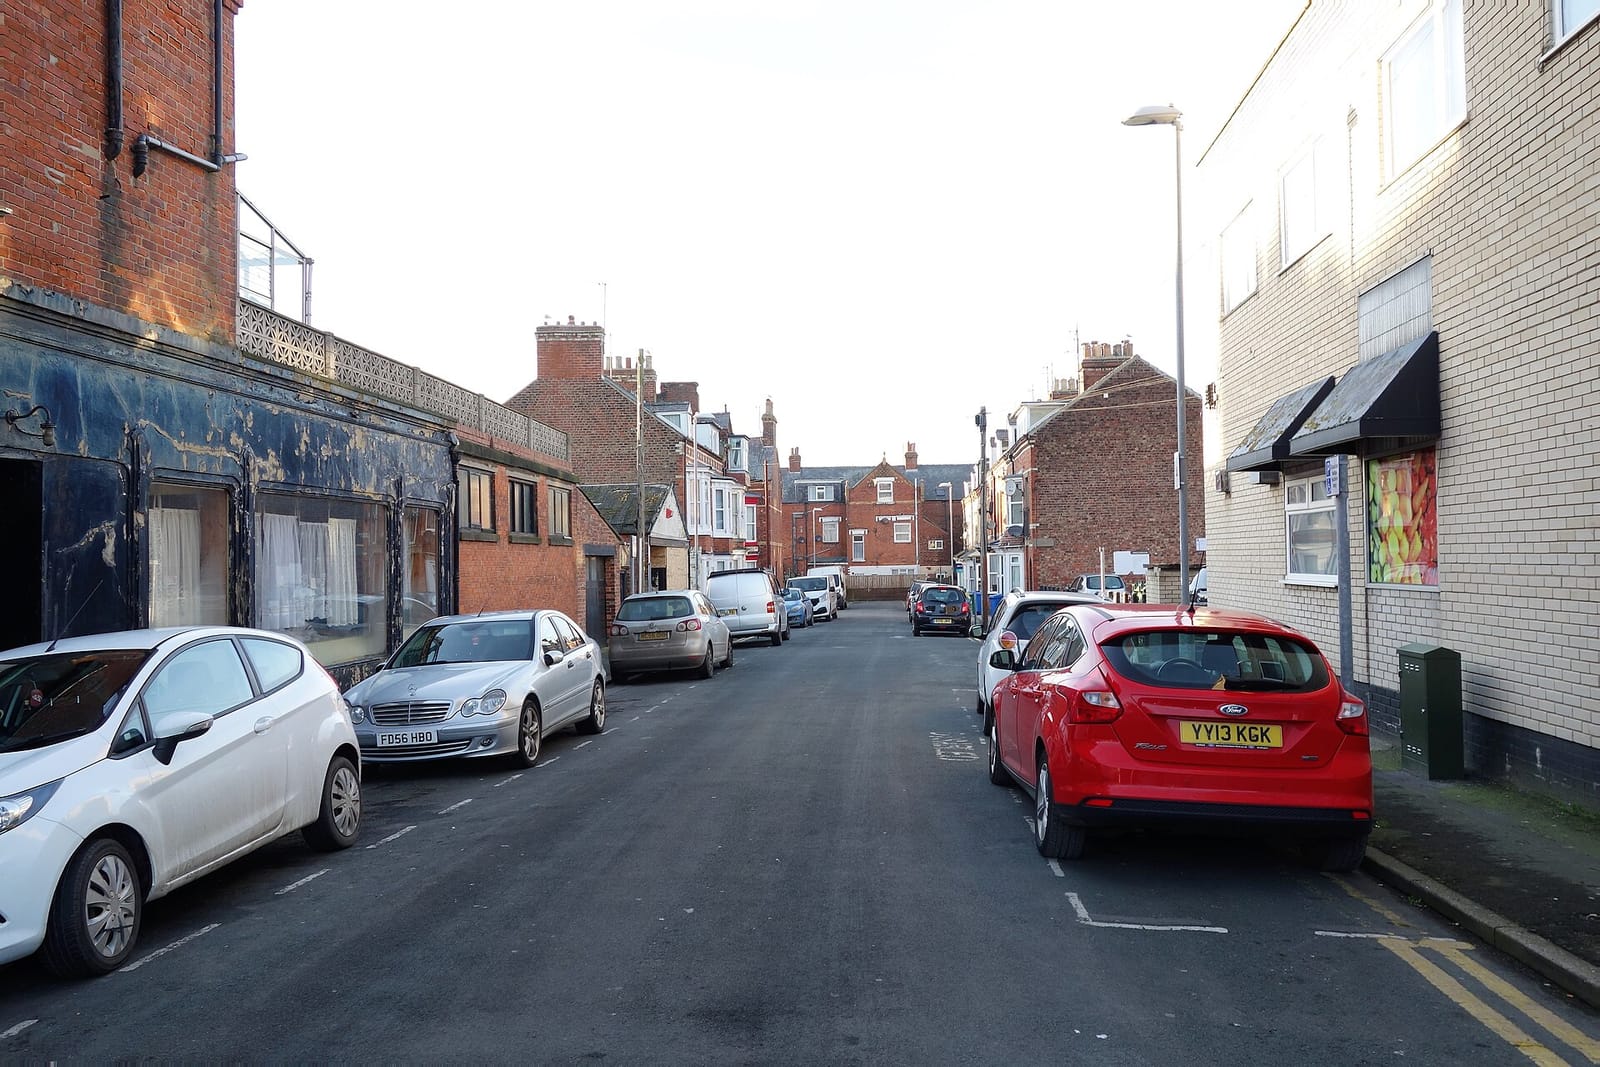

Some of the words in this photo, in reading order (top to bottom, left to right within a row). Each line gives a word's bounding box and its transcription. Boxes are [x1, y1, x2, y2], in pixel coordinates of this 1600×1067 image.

[1225, 704, 1244, 714] Ford
[380, 733, 408, 745] FD56
[411, 731, 432, 743] HBO
[1192, 723, 1231, 741] YY13
[1236, 725, 1271, 743] KGK
